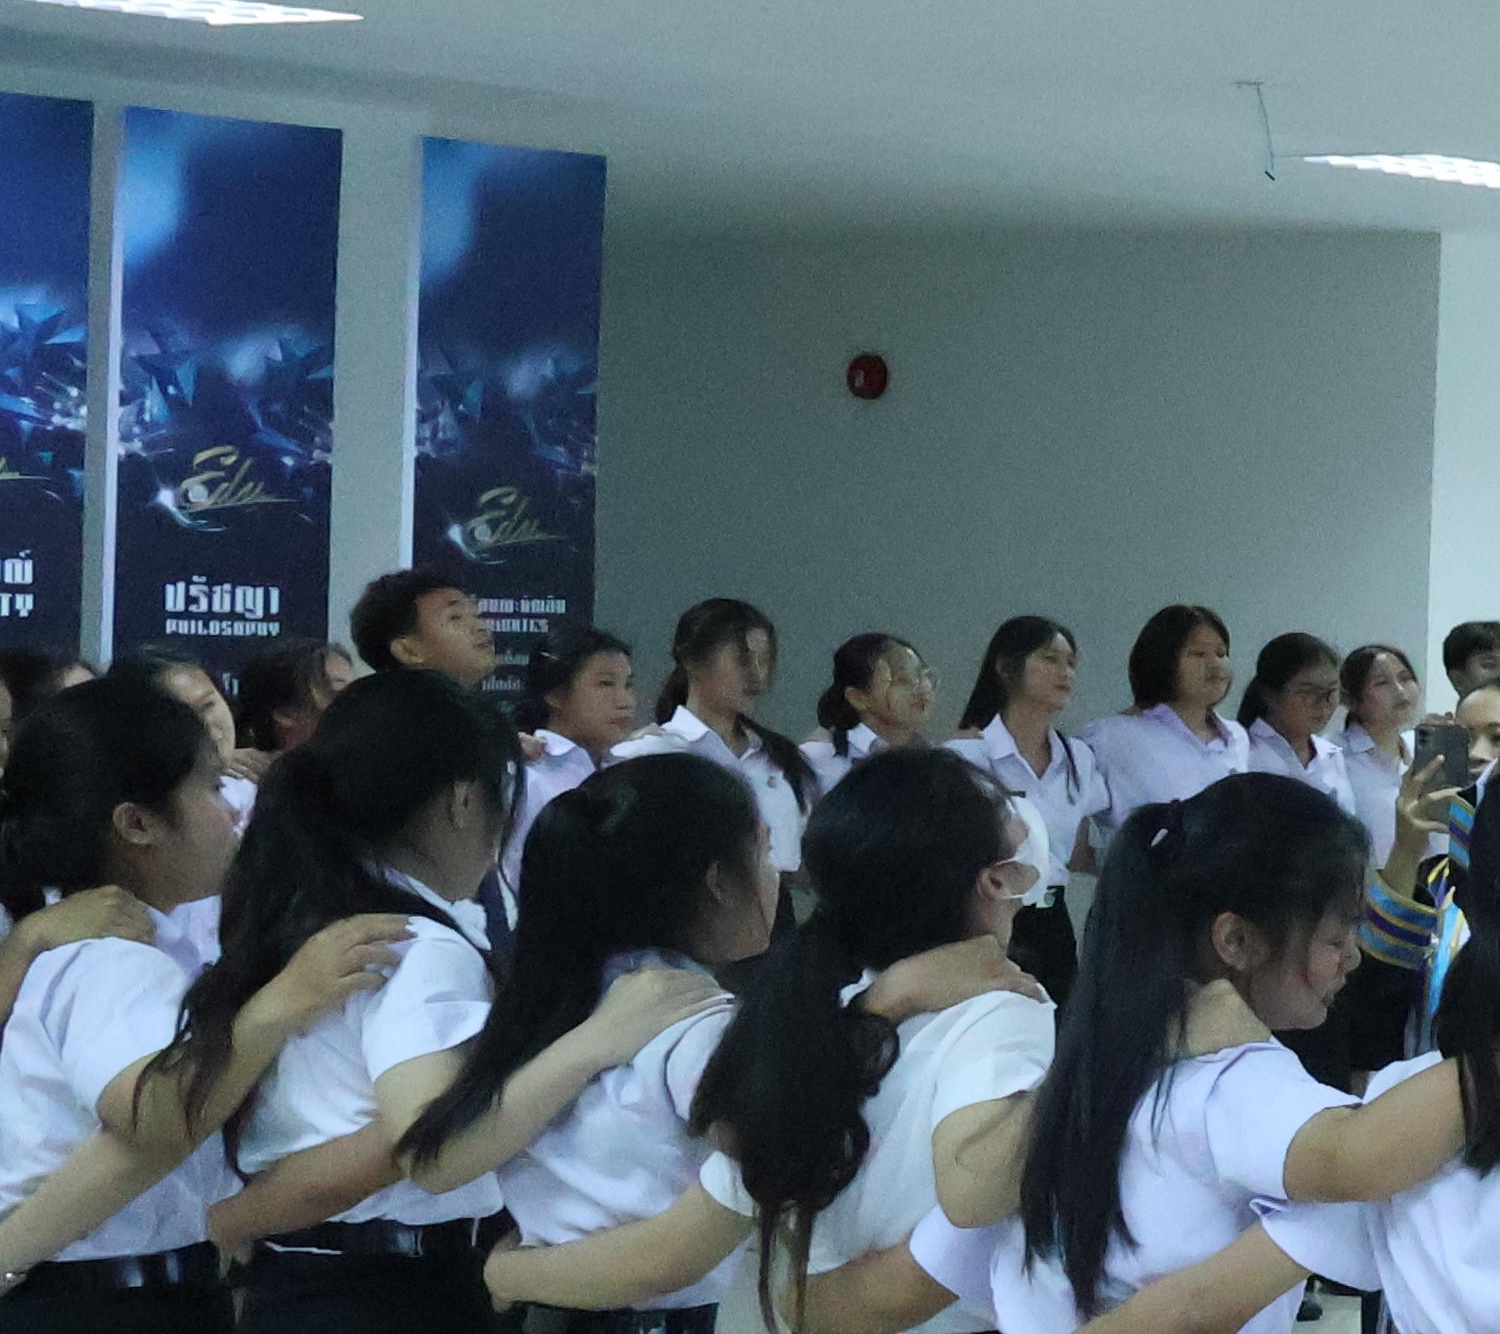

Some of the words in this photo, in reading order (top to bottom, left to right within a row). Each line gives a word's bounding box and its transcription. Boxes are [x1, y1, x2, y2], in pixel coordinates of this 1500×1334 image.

[164, 574, 281, 619] ปรัชญา
[165, 617, 281, 637] PHILOSOPHY
